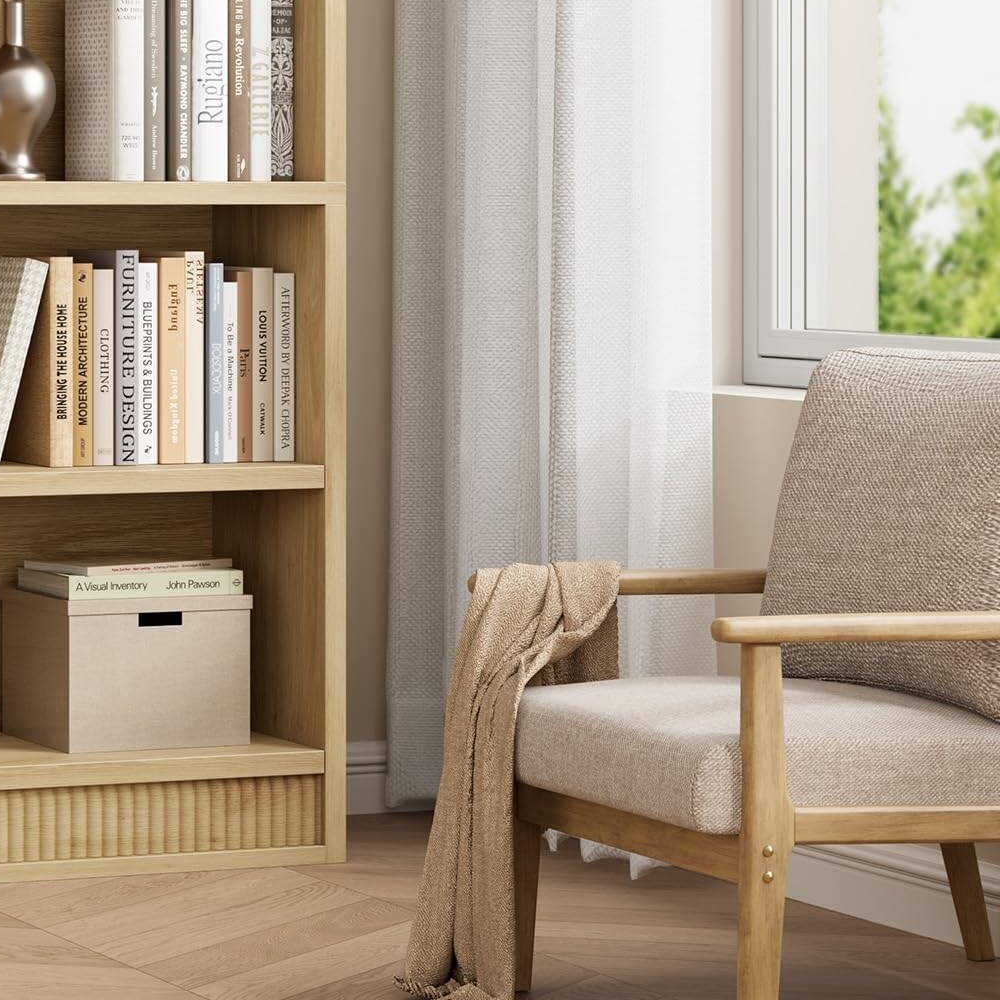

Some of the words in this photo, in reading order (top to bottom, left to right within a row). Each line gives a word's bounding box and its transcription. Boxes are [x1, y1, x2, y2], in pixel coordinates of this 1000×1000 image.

[180, 10, 188, 26] BIG
[235, 23, 244, 36] the
[180, 29, 188, 54] SLEEP
[197, 39, 225, 125] Rugiano
[235, 38, 244, 96] Revolution
[180, 64, 188, 110] RAYMOND
[180, 112, 188, 159] CHANDLER
[57, 303, 67, 328] HOME
[121, 254, 136, 378] FURNITURE
[142, 301, 152, 366] BLUEPRINTS
[227, 322, 234, 332] To
[258, 310, 267, 339] LOUIS
[281, 286, 291, 350] AFTERWORD
[57, 329, 67, 358] HOUSE
[78, 297, 88, 378] ARCHITECTURE
[227, 335, 234, 346] Be
[57, 360, 67, 377] THE
[99, 328, 110, 393] CLOTHING
[240, 348, 250, 378] Paris
[258, 341, 267, 382] VUITTON
[281, 354, 291, 365] BY
[57, 381, 67, 420] BRINGING
[78, 380, 88, 426] MODERN
[281, 368, 291, 406] DEEPAK
[121, 385, 136, 463] DESIGN
[142, 379, 152, 435] BUILDINGS
[281, 410, 291, 449] CHOPRA
[75, 583, 84, 592] A
[84, 581, 109, 592] Visual
[110, 580, 148, 592] Inventory
[165, 580, 186, 590] John
[187, 579, 221, 590] Pawson
